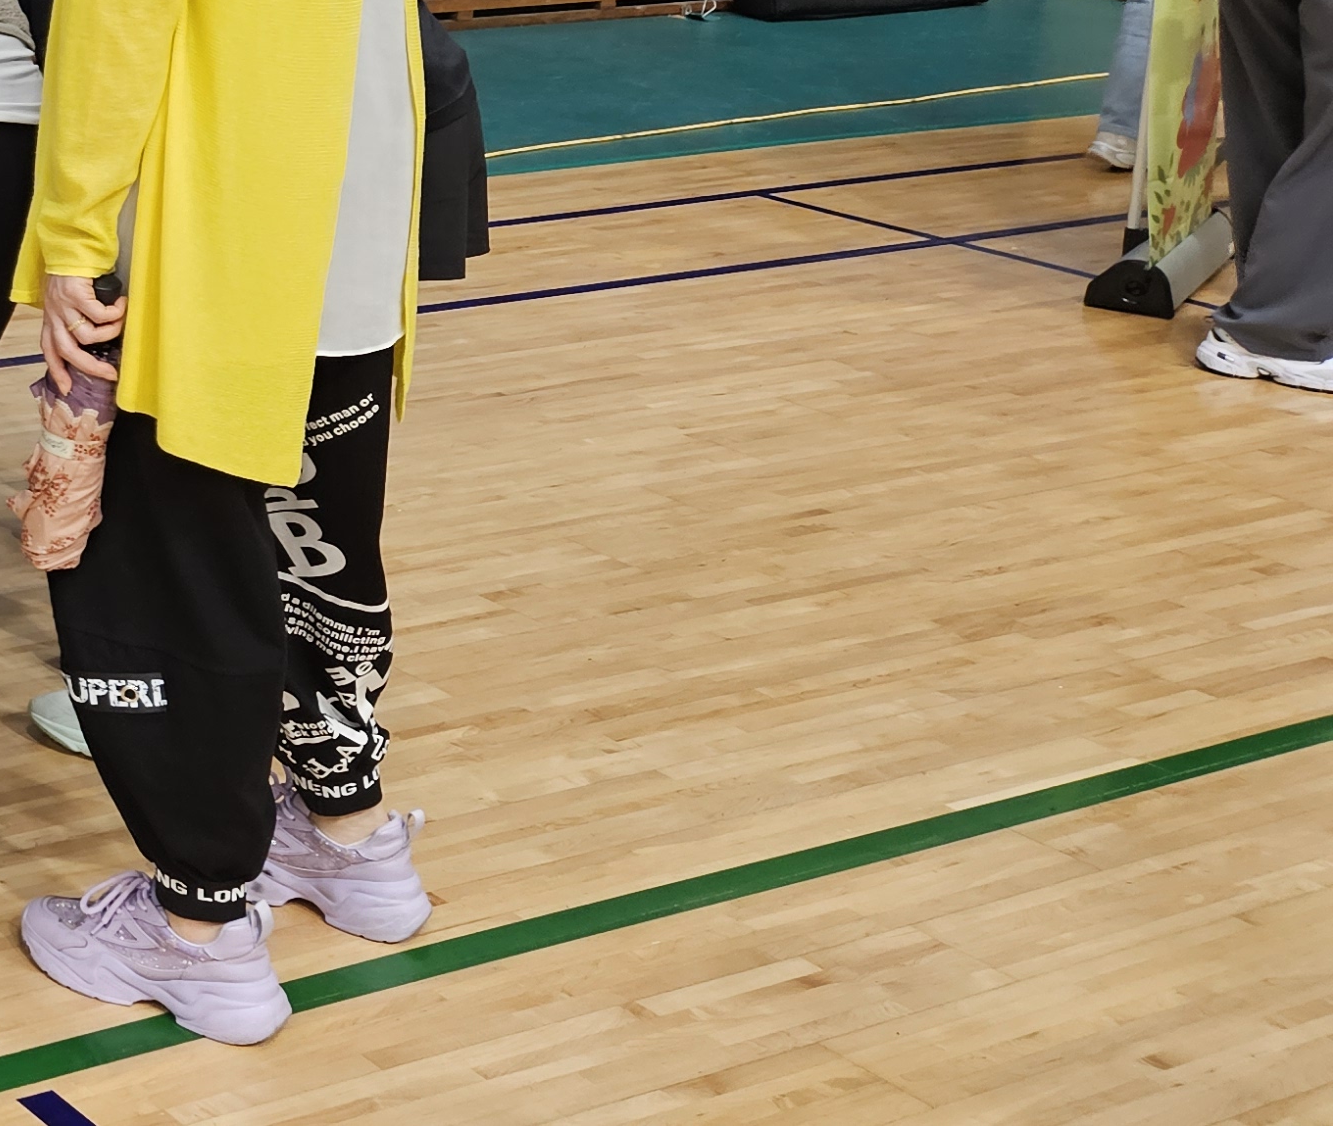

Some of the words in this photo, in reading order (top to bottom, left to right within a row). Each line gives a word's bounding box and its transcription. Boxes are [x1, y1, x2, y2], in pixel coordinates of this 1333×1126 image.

[329, 404, 360, 423] man
[359, 393, 374, 408] or
[309, 431, 333, 447] you
